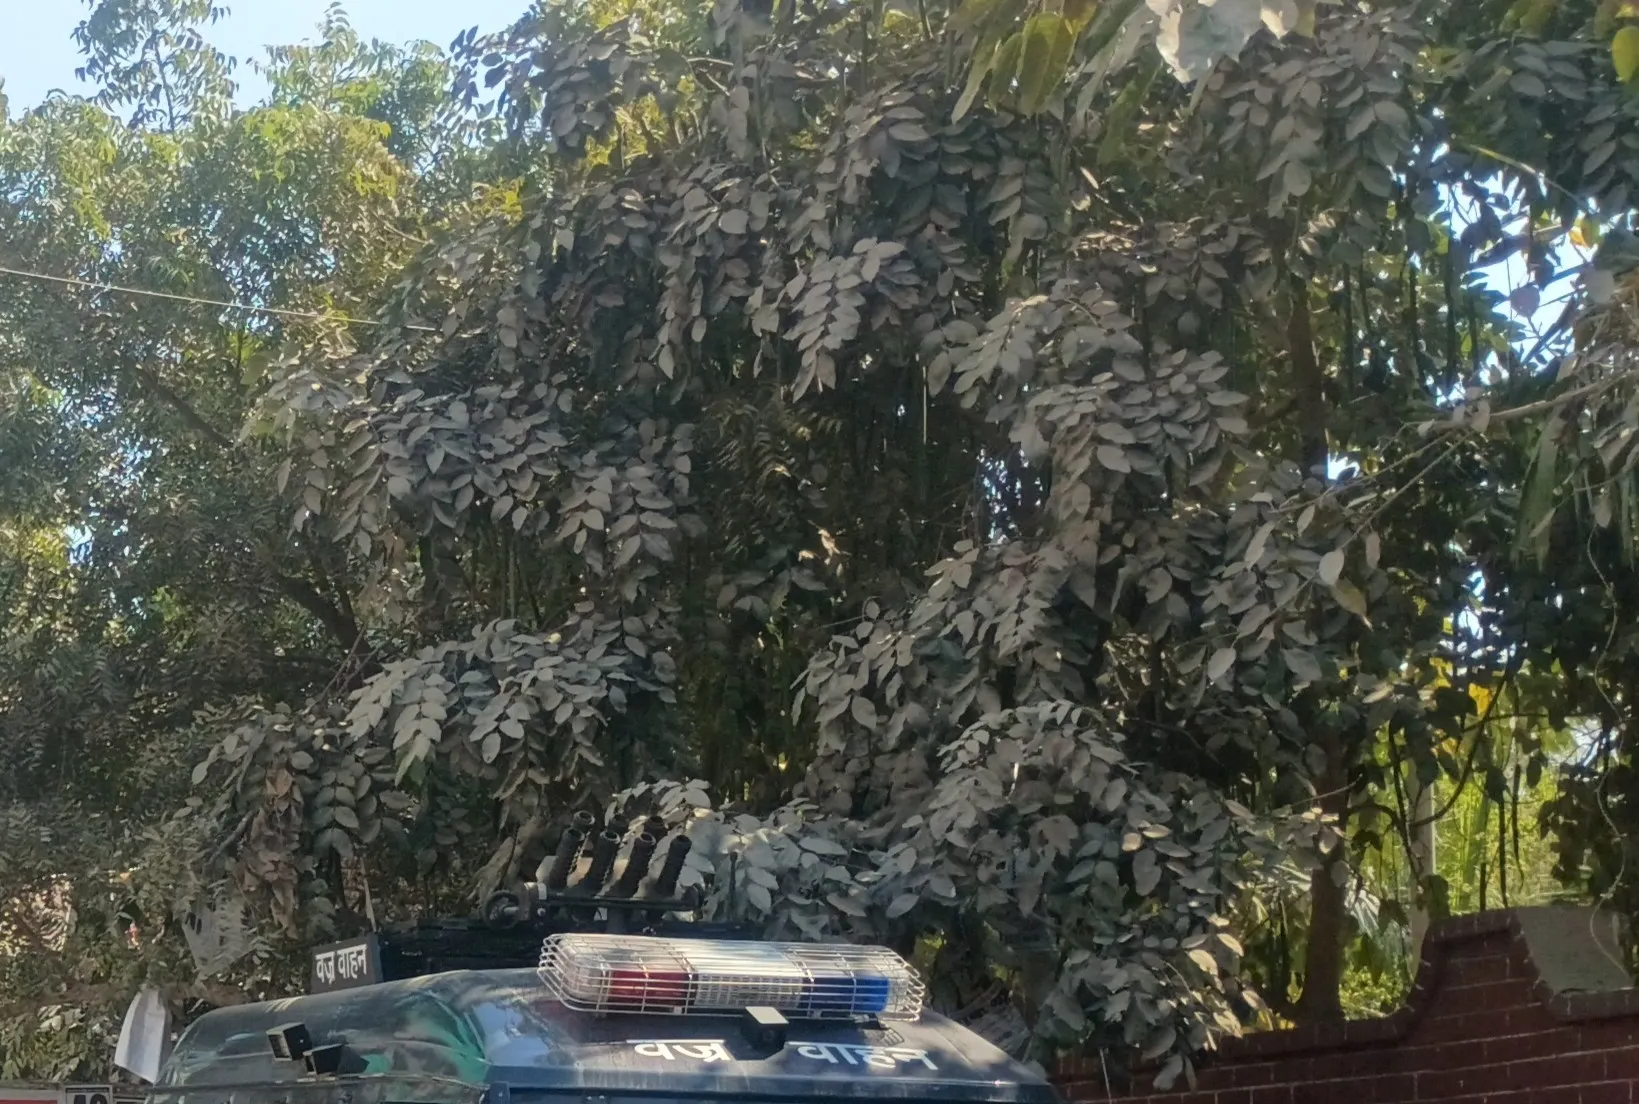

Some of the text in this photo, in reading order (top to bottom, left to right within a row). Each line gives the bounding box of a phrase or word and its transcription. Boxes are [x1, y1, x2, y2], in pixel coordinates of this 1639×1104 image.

[315, 943, 368, 985] वज्र वाहन
[624, 1039, 939, 1071] वज्र वाहन
